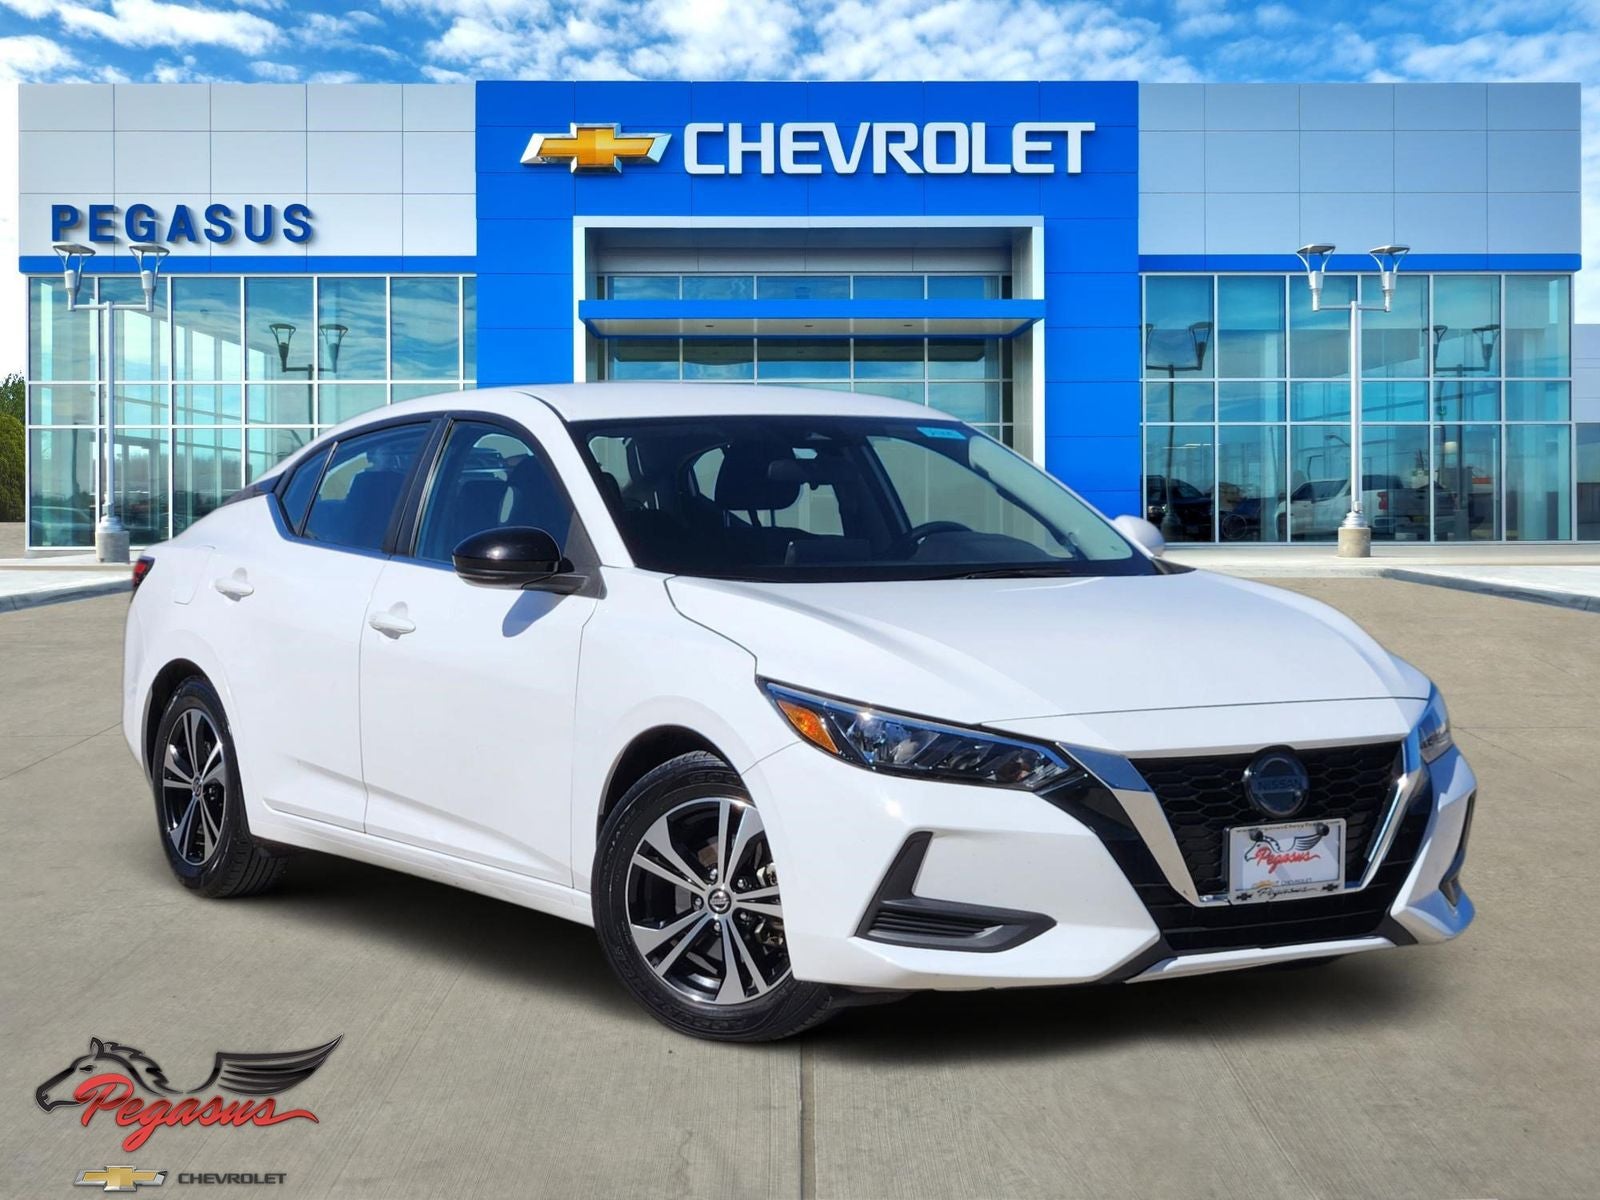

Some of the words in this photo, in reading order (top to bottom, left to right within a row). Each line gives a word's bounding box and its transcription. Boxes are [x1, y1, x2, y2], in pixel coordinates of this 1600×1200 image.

[684, 122, 1096, 175] CHEVROLET
[51, 203, 314, 244] PEGASUS
[1255, 846, 1320, 874] Pegasus
